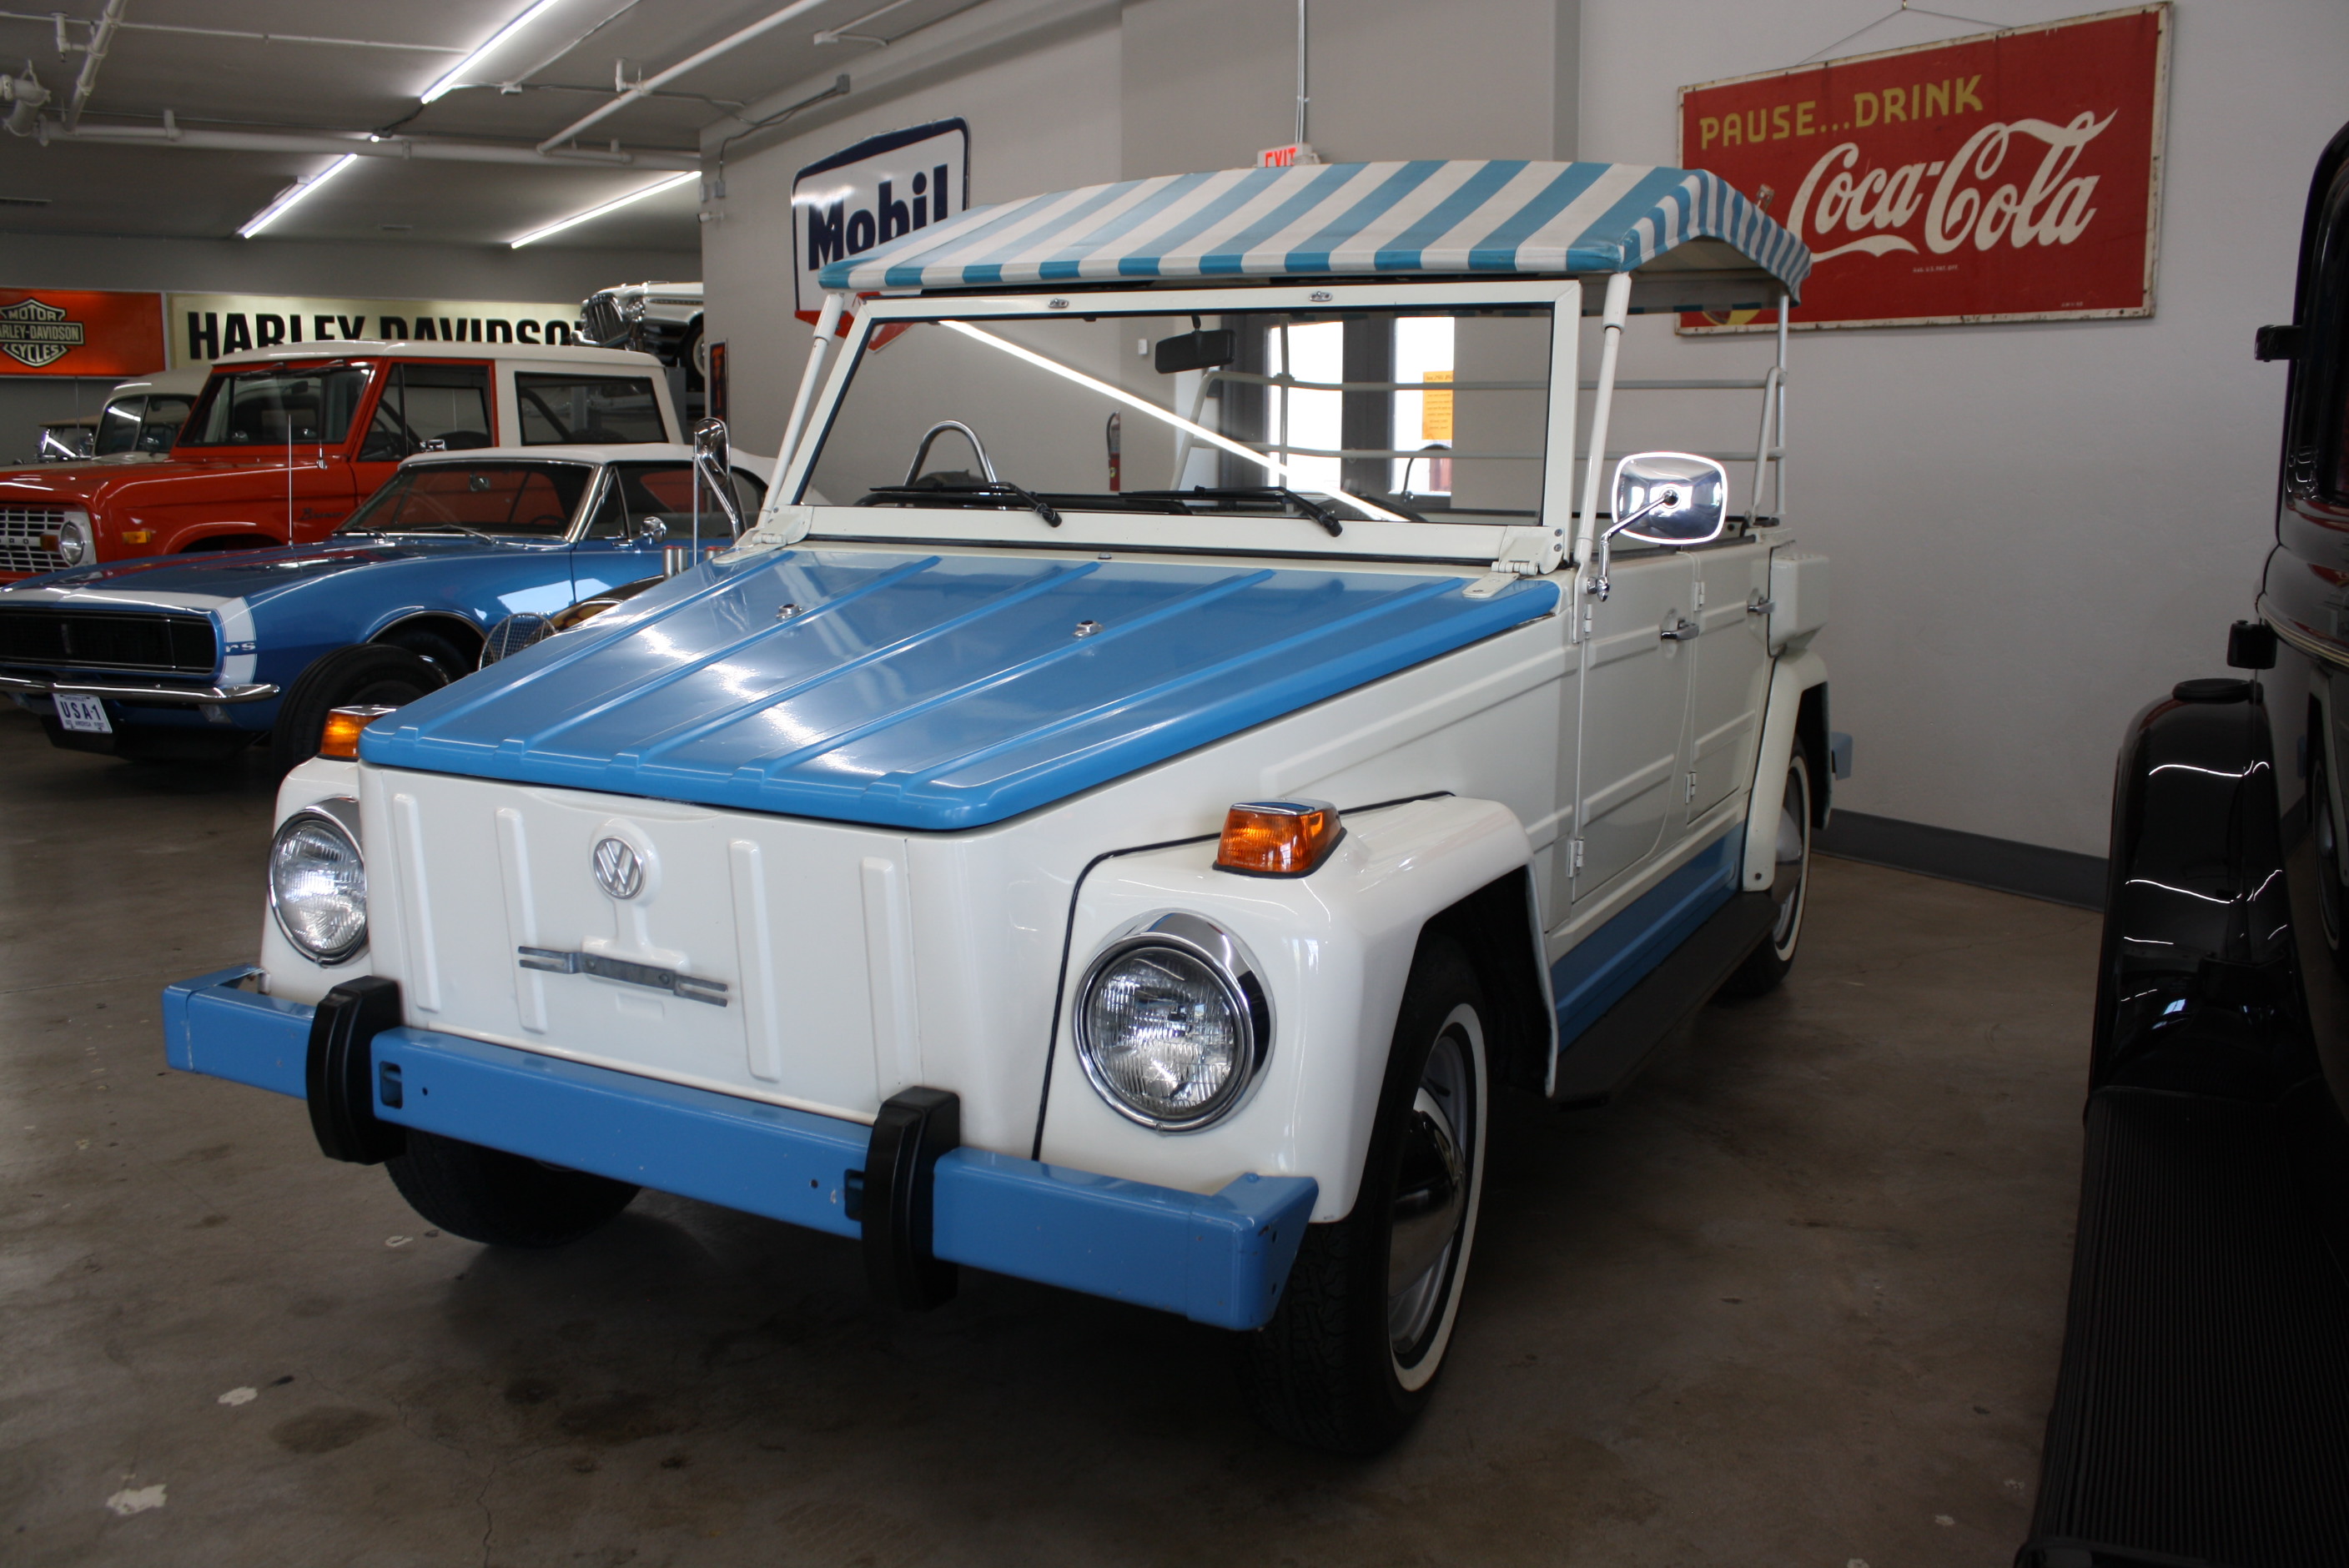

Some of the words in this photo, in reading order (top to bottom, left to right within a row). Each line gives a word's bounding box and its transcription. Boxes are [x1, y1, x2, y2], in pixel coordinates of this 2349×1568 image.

[1787, 108, 2119, 263] Coca-Cola
[808, 163, 948, 271] Mobil
[8, 304, 57, 321] MOTOR
[0, 324, 79, 341] RLEY-DAVIDSON
[380, 315, 582, 346] DAVIDSO
[11, 344, 60, 363] CYCLES
